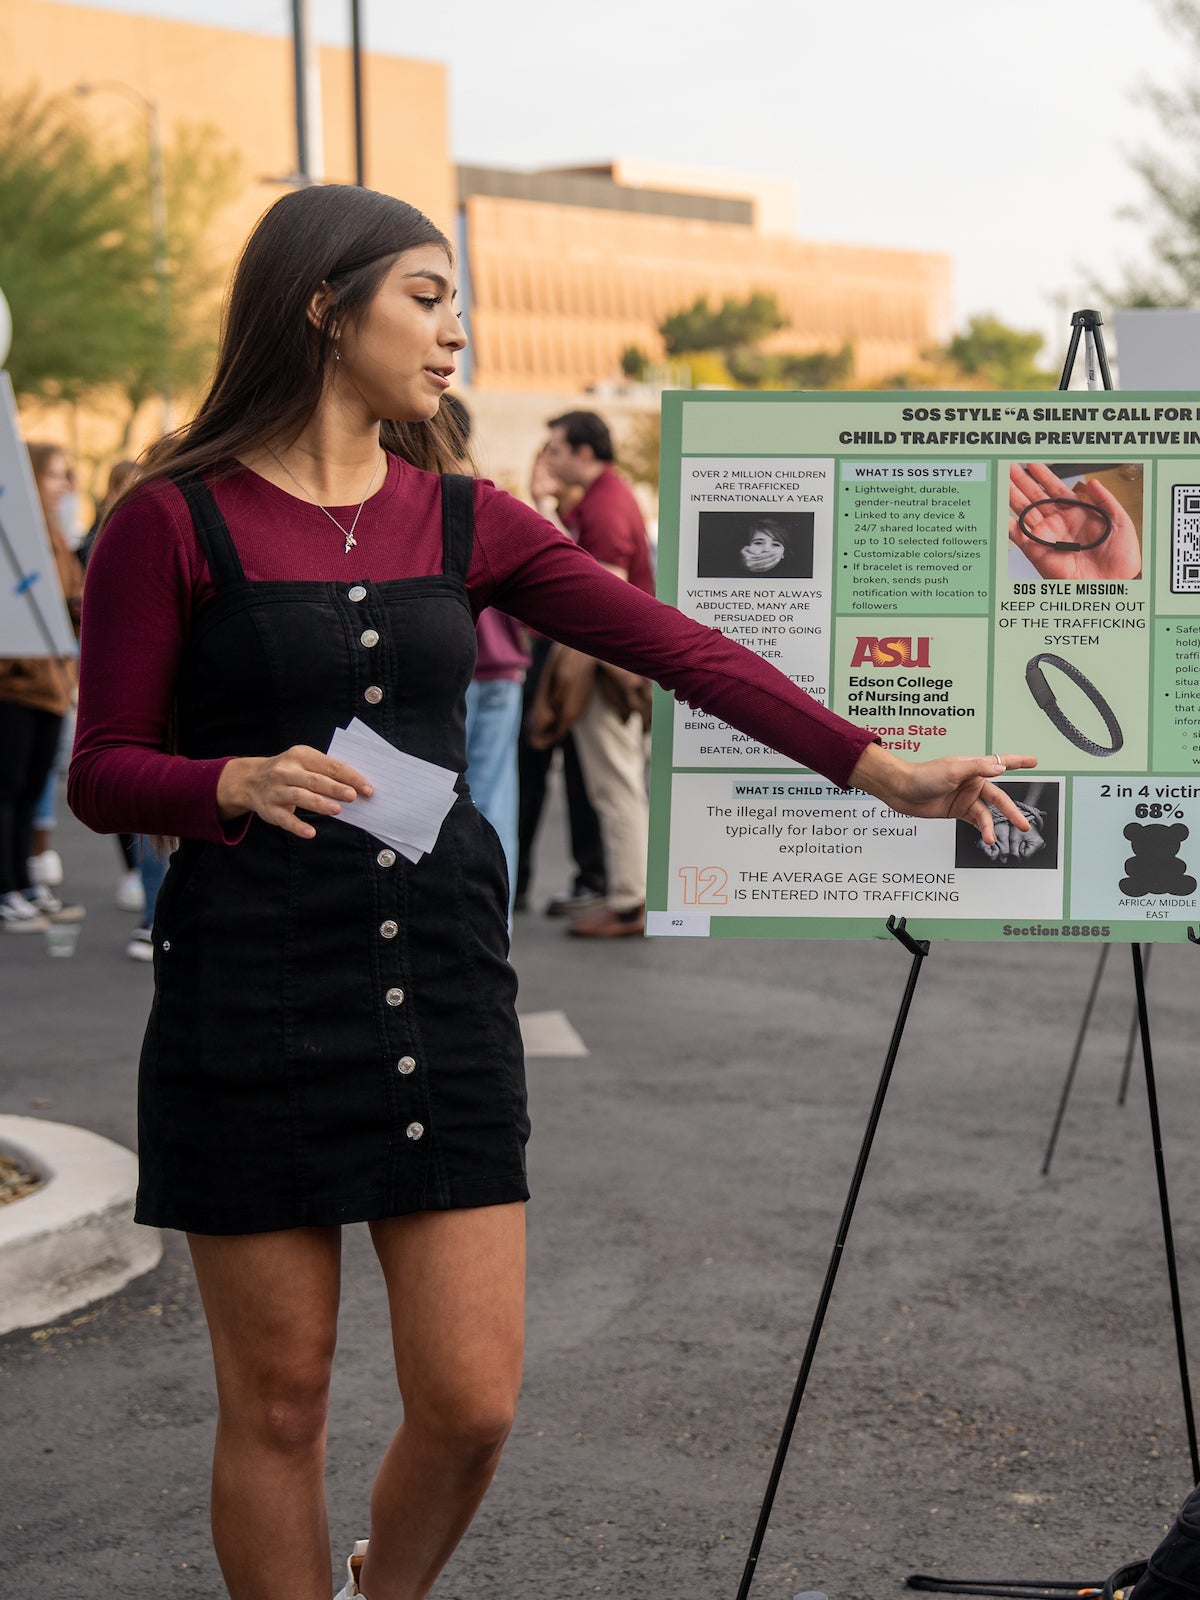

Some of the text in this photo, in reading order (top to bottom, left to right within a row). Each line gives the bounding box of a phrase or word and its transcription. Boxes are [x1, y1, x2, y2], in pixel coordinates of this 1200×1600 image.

[902, 408, 941, 421] SOS
[944, 408, 1001, 421] STYLE
[1033, 408, 1099, 421] SILENT
[1102, 408, 1151, 421] CALL
[1154, 407, 1193, 421] FOR
[839, 431, 897, 445] CHILD
[900, 431, 1032, 445] TRAFFICKING
[1035, 431, 1180, 445] PREVENTATIVE
[692, 470, 720, 478] OVER
[723, 470, 729, 478] 2
[775, 470, 826, 479] CHILDREN
[855, 468, 973, 477] WHAT IS SOS STYLE?
[714, 482, 800, 491] ARE TRAFFICKED
[855, 485, 960, 495] Lightweight, durable,
[690, 494, 784, 502] INTERNATIONALLY
[796, 494, 824, 503] YEAR
[854, 498, 971, 508] gender-neutral bracelet
[854, 523, 977, 533] 24/7 shared located with
[853, 549, 981, 559] Customizable colors/sizes
[686, 590, 728, 598] VICTIMS
[730, 590, 751, 598] ARE
[1013, 583, 1128, 595] SOS SYLE MISSION:
[695, 602, 754, 610] ABDUCTED,
[1001, 601, 1145, 612] KEEP CHILDREN OUT
[714, 614, 794, 622] PERSUADED OR
[999, 618, 1146, 629] OF THE TRAFFICKING
[1044, 635, 1099, 645] SYSTEM
[1176, 638, 1200, 648] hold)
[850, 636, 931, 668] ASU
[849, 676, 953, 690] Edson College
[848, 690, 949, 704] of Nursing and
[848, 705, 975, 717] Health Innovation
[700, 746, 743, 755] BEATEN,
[735, 786, 823, 795] WHAT IS CHILD
[1100, 784, 1111, 797] 2
[1117, 784, 1132, 798] in
[1138, 785, 1150, 798] 4
[706, 806, 877, 820] The illegal movement of
[1135, 803, 1184, 819] 68%
[726, 824, 917, 838] typically for labor or sexual
[779, 842, 862, 856] exploitation
[739, 871, 955, 884] THE AVERAGE AGE SOMEONE
[678, 866, 728, 905] 12
[734, 889, 959, 902] IS ENTERED INTO TRAFFICKING
[1118, 898, 1197, 907] AFRICA/ MIDDLE
[1146, 910, 1169, 919] EAST
[1002, 924, 1111, 937] Section 88865
